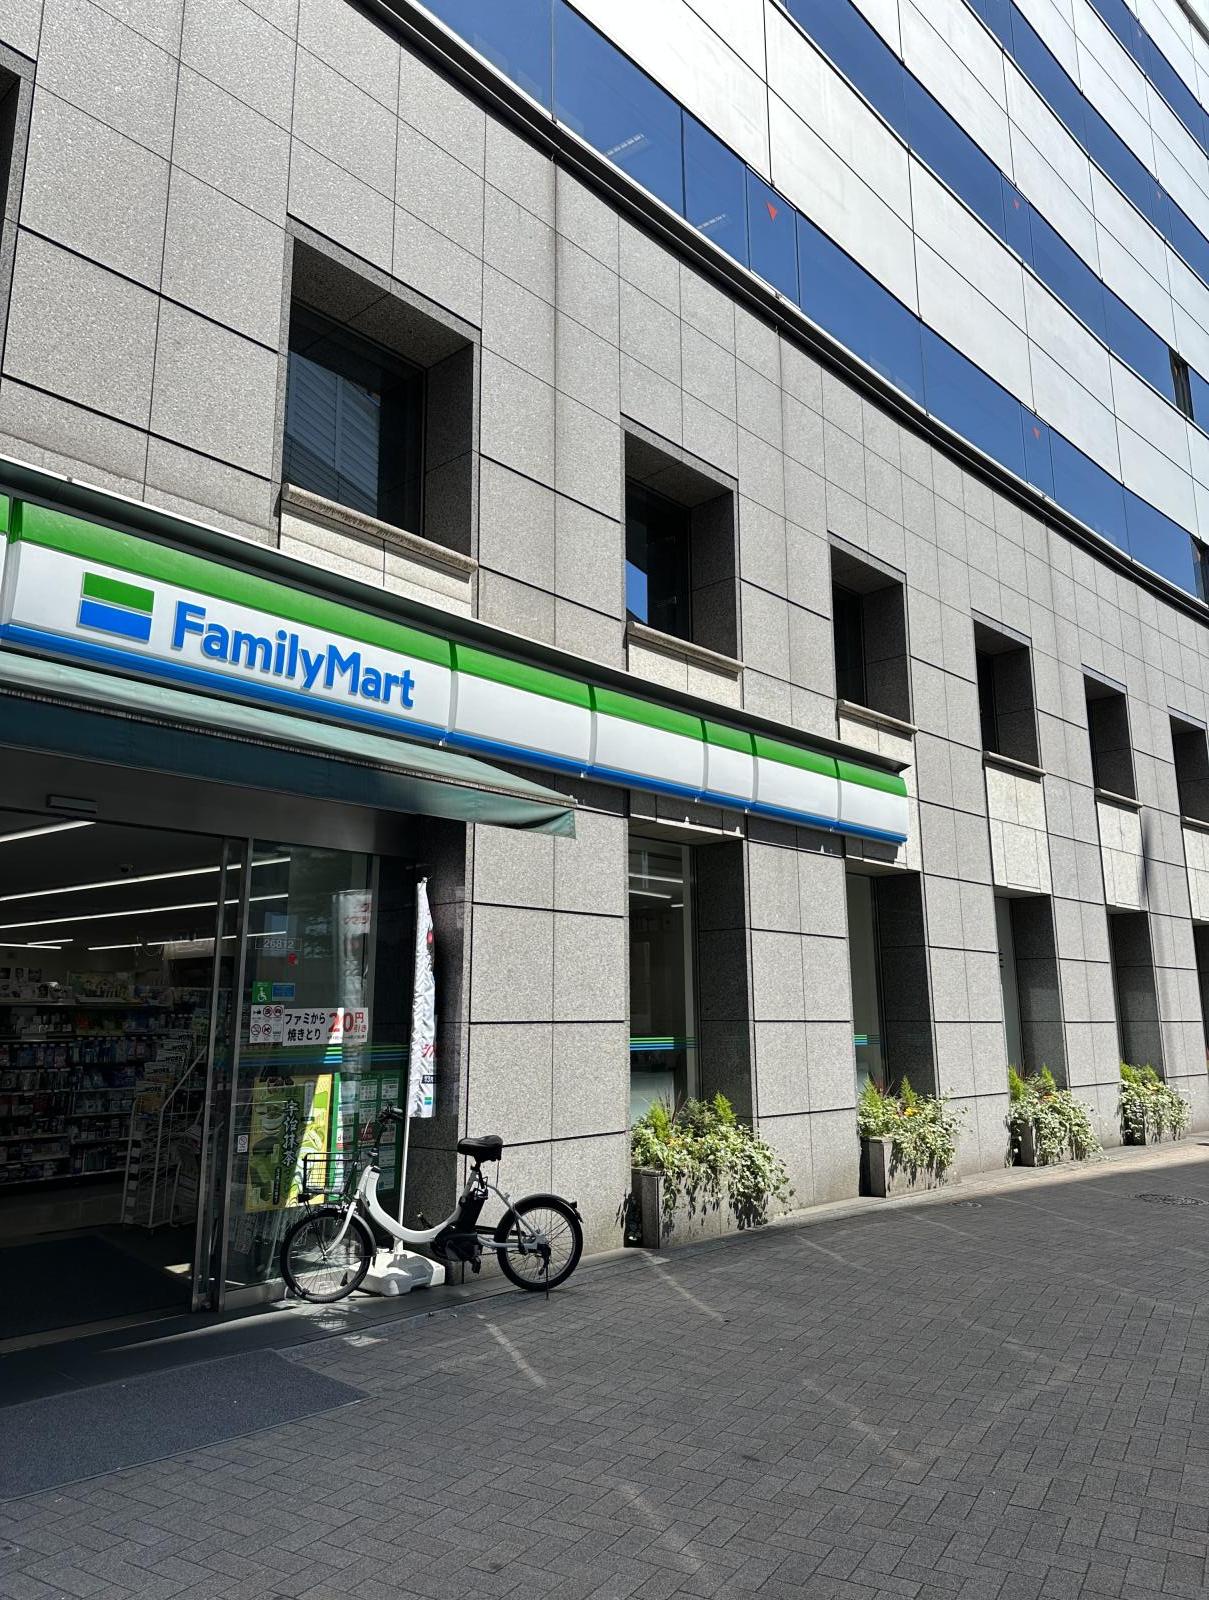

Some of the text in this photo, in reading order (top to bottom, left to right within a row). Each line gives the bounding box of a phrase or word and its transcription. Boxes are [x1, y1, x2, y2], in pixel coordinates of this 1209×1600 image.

[171, 600, 415, 709] FamilyMart
[284, 1012, 326, 1026] ファミから
[287, 1028, 321, 1041] 焼きとり
[282, 1099, 299, 1167] 宇治抹茶
